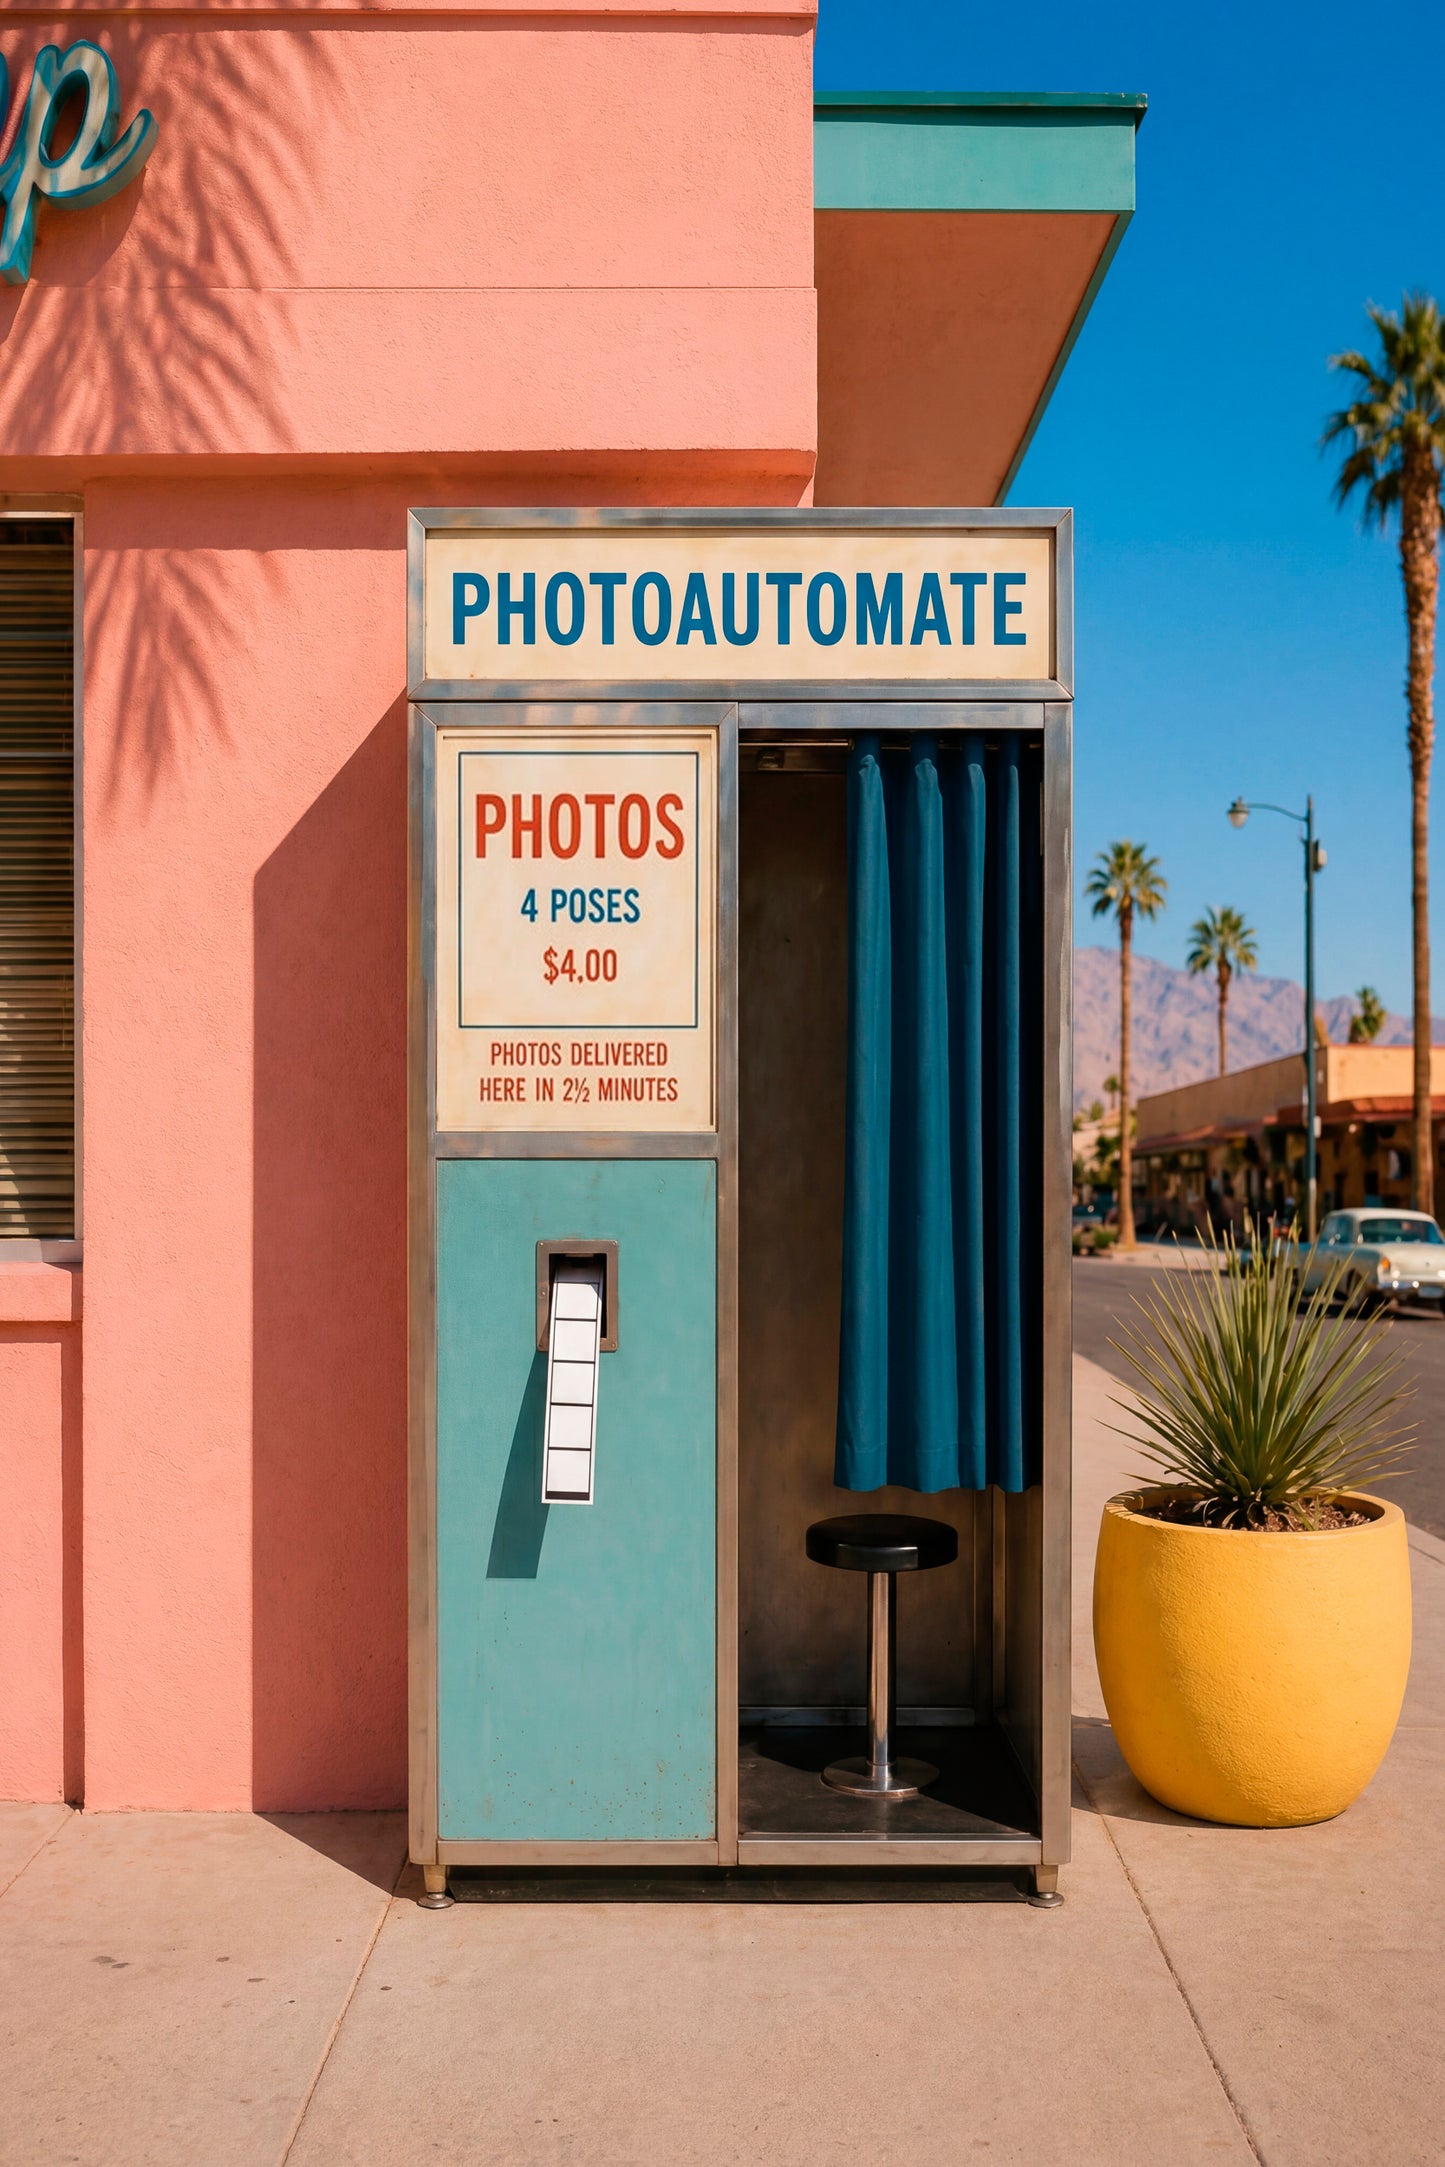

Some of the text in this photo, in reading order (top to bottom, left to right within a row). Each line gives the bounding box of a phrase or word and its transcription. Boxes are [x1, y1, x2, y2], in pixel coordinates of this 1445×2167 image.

[0, 39, 159, 285] p
[452, 571, 1027, 646] PHOTOAUTOMATE
[475, 793, 685, 860] PHOTOS
[520, 887, 641, 923] 4 POSES
[490, 1042, 668, 1066] PHOTOS DELIVERED
[479, 1077, 527, 1102] HERE
[535, 1077, 554, 1102] IN
[598, 1077, 679, 1102] MINUTES
